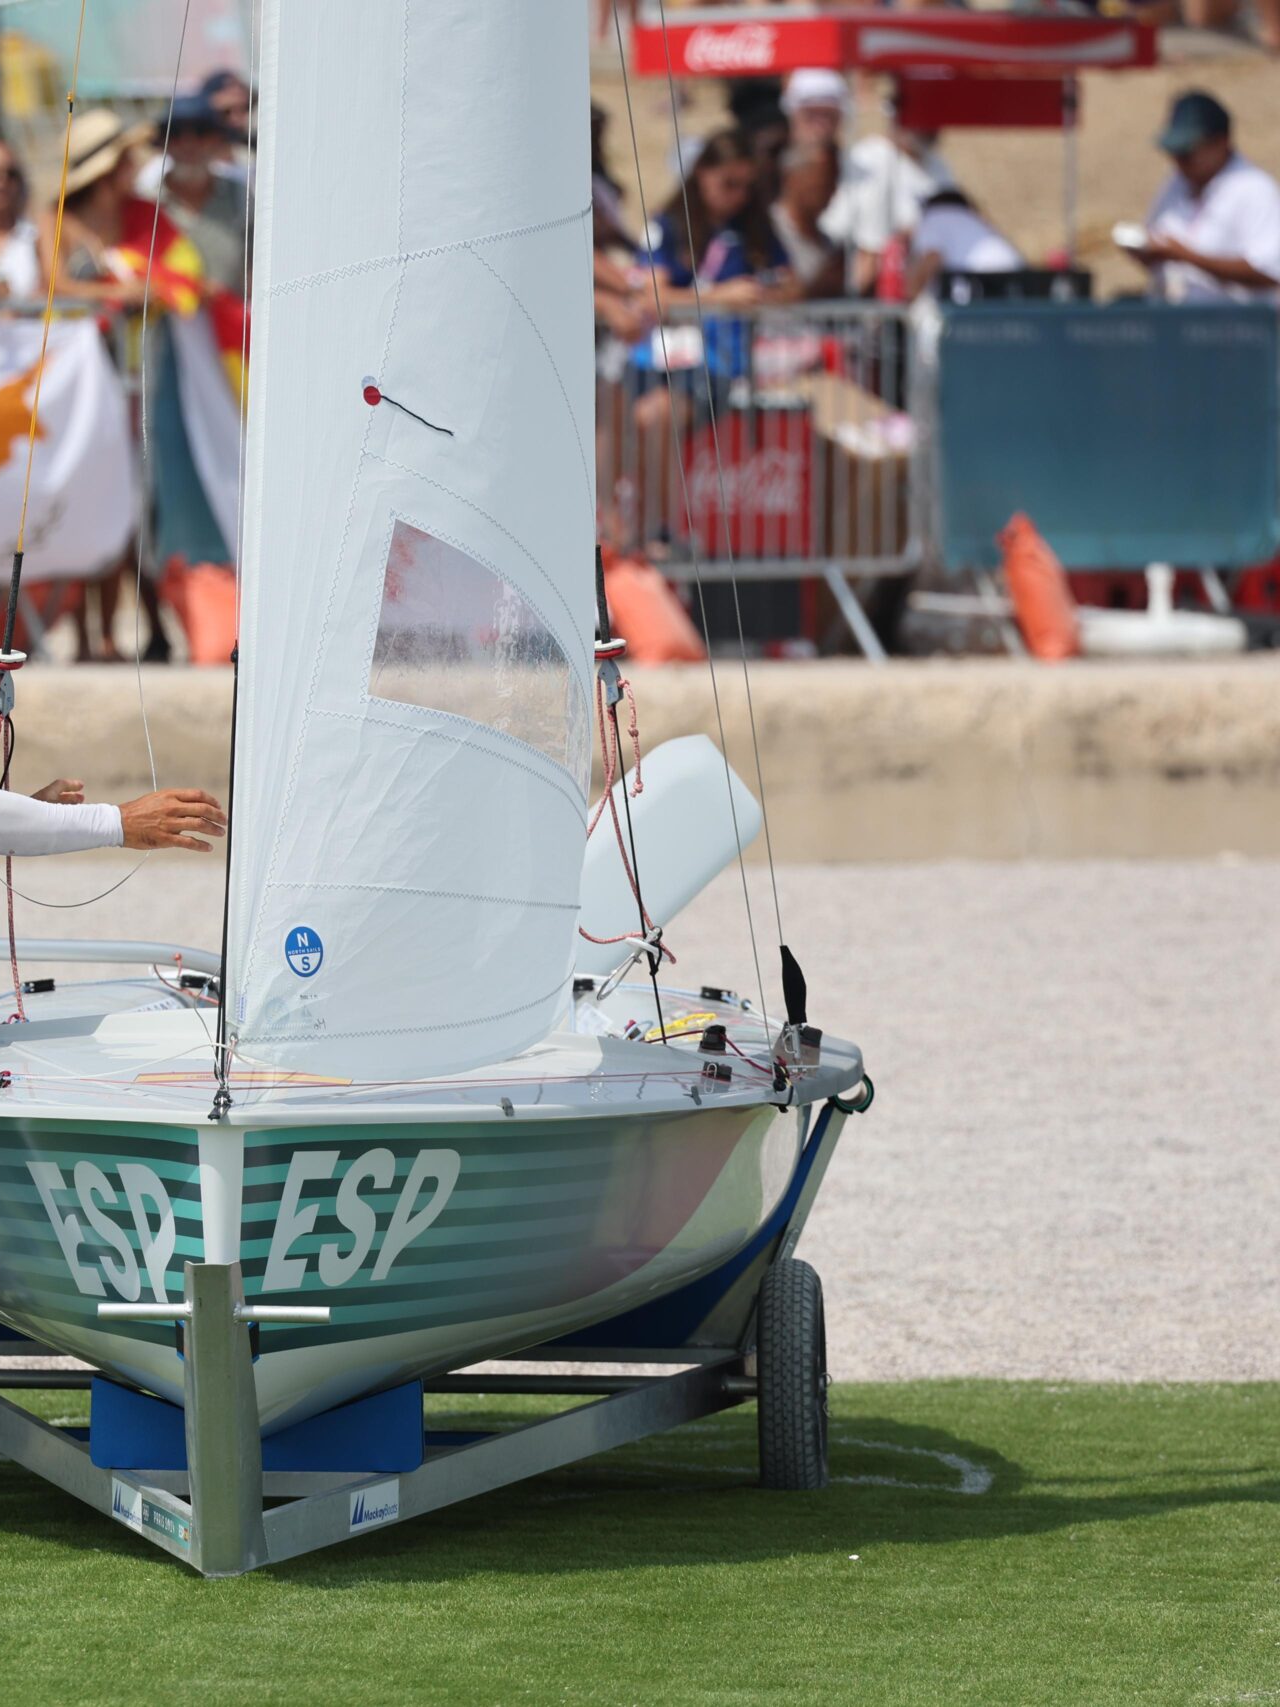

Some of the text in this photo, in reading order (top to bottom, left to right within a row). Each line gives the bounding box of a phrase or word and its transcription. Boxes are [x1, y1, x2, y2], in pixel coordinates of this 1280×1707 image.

[296, 931, 309, 948] N
[287, 946, 321, 956] NORTH SAILS
[301, 955, 311, 972] S
[261, 1147, 462, 1292] ESP
[25, 1160, 177, 1303] ESP
